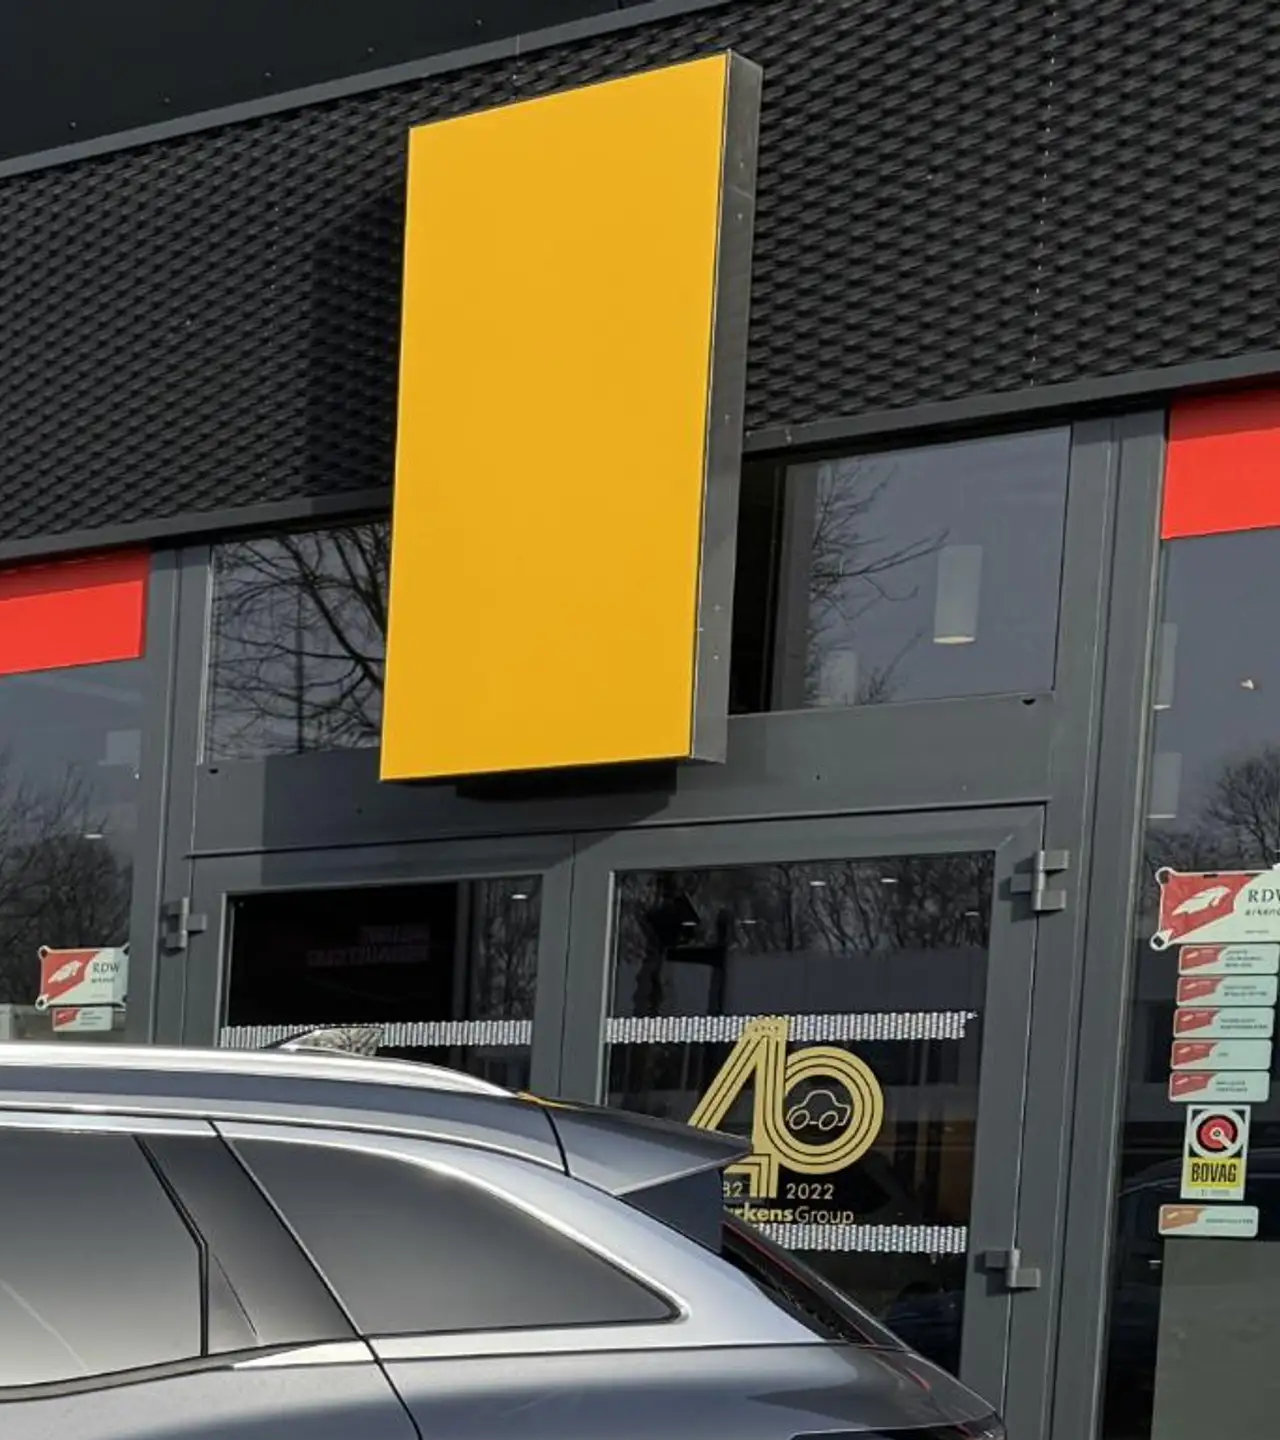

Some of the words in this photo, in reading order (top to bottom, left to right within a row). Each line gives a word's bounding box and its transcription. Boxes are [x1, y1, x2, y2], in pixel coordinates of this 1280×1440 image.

[1248, 888, 1280, 903] RD
[92, 962, 120, 973] RDW
[1191, 1163, 1237, 1182] BOVAG
[786, 1183, 835, 1200] 2022
[730, 1202, 855, 1225] rkensGroup
